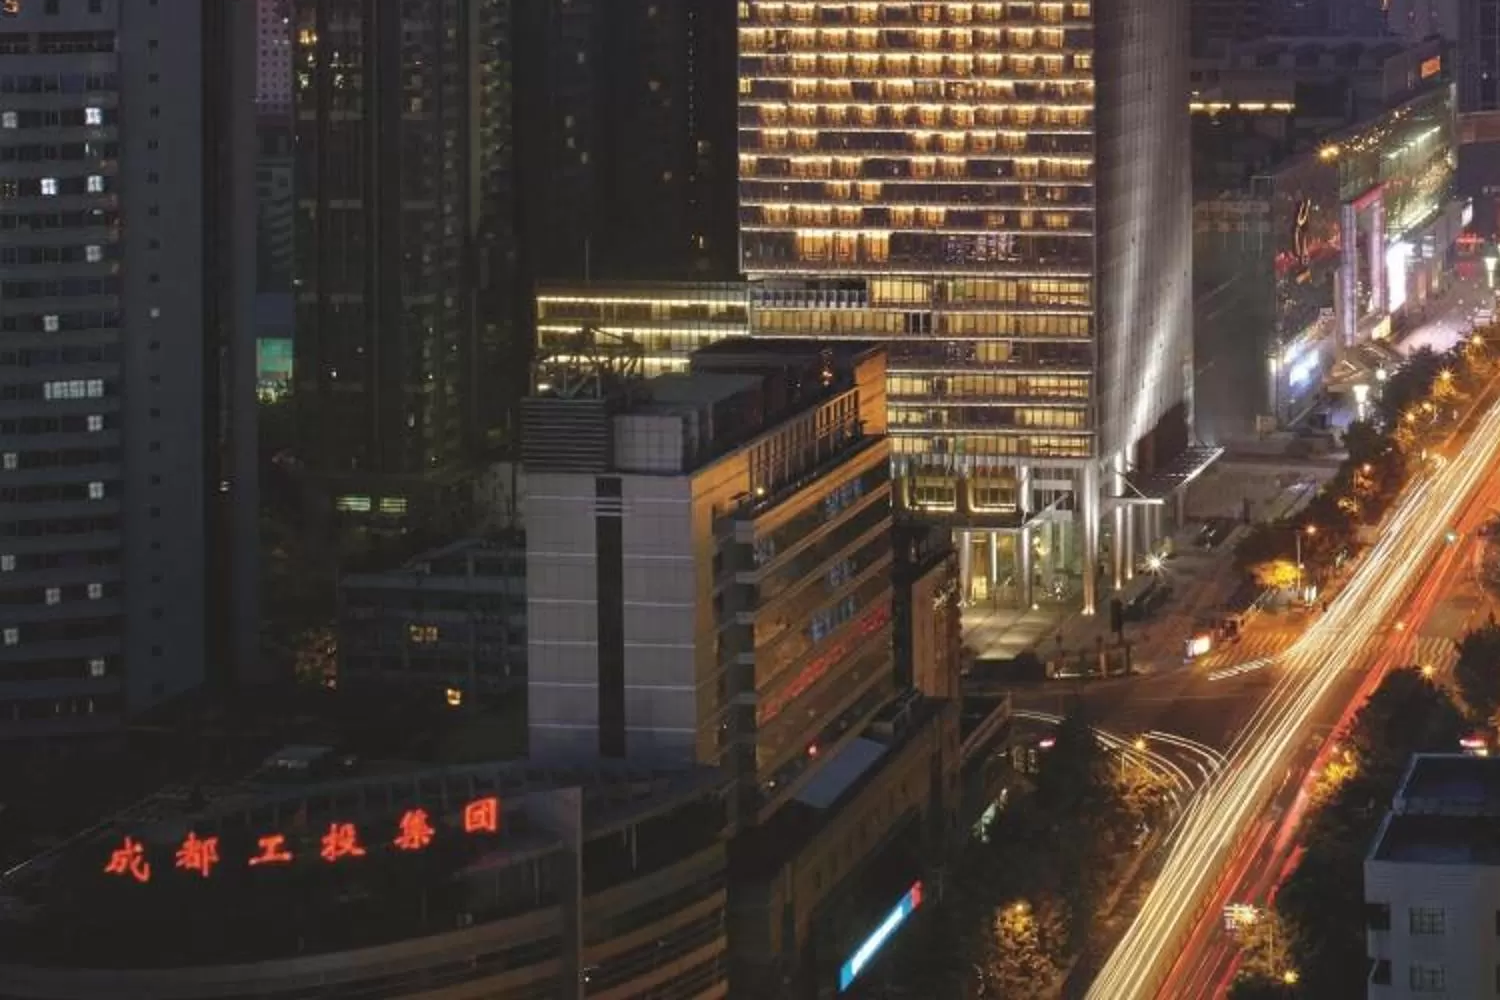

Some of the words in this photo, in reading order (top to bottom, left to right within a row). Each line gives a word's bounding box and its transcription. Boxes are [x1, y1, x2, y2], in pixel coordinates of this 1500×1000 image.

[105, 797, 498, 882] 成都工投集团
